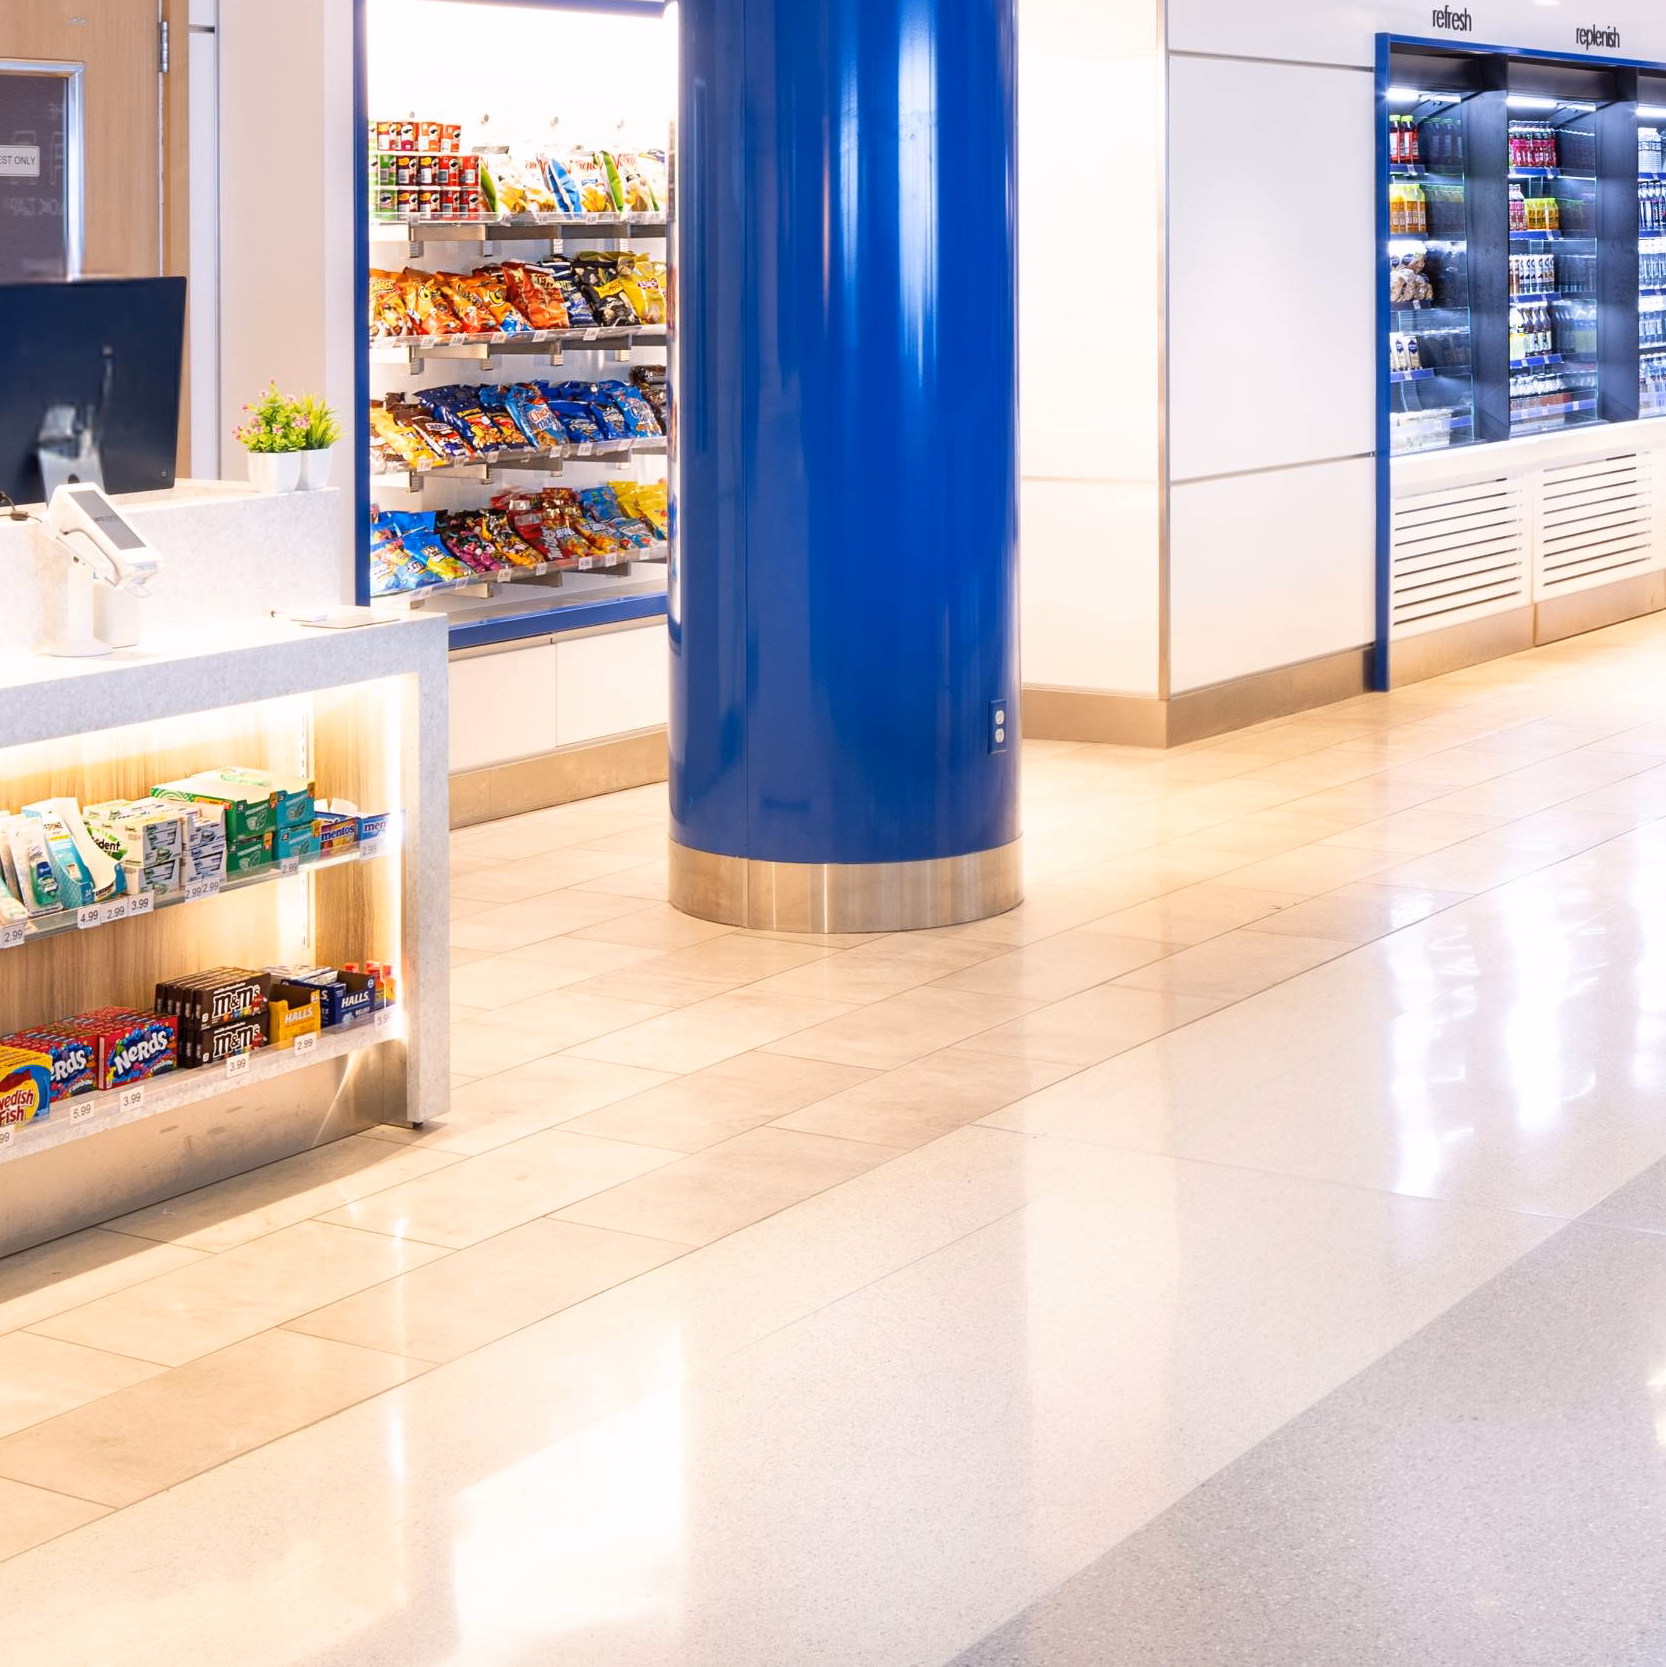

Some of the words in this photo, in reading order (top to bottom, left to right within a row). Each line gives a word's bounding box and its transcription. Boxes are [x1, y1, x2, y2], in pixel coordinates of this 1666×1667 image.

[1432, 4, 1472, 32] refresh
[1575, 24, 1620, 50] replenish
[14, 155, 36, 166] ONLY
[321, 824, 355, 841] mentos
[364, 820, 387, 832] men
[284, 863, 298, 874] 2.99
[202, 882, 219, 893] 2.99
[131, 898, 149, 911] 3.99
[80, 910, 99, 923] 4.99
[107, 906, 125, 919] 2.99
[4, 928, 23, 943] 2.99
[341, 990, 370, 1008] HALLS
[284, 1006, 314, 1024] HALLS
[297, 1038, 314, 1051] 2.99
[229, 1058, 246, 1072] 3.99
[123, 1092, 141, 1106] 3.99
[73, 1104, 91, 1119] 5.99
